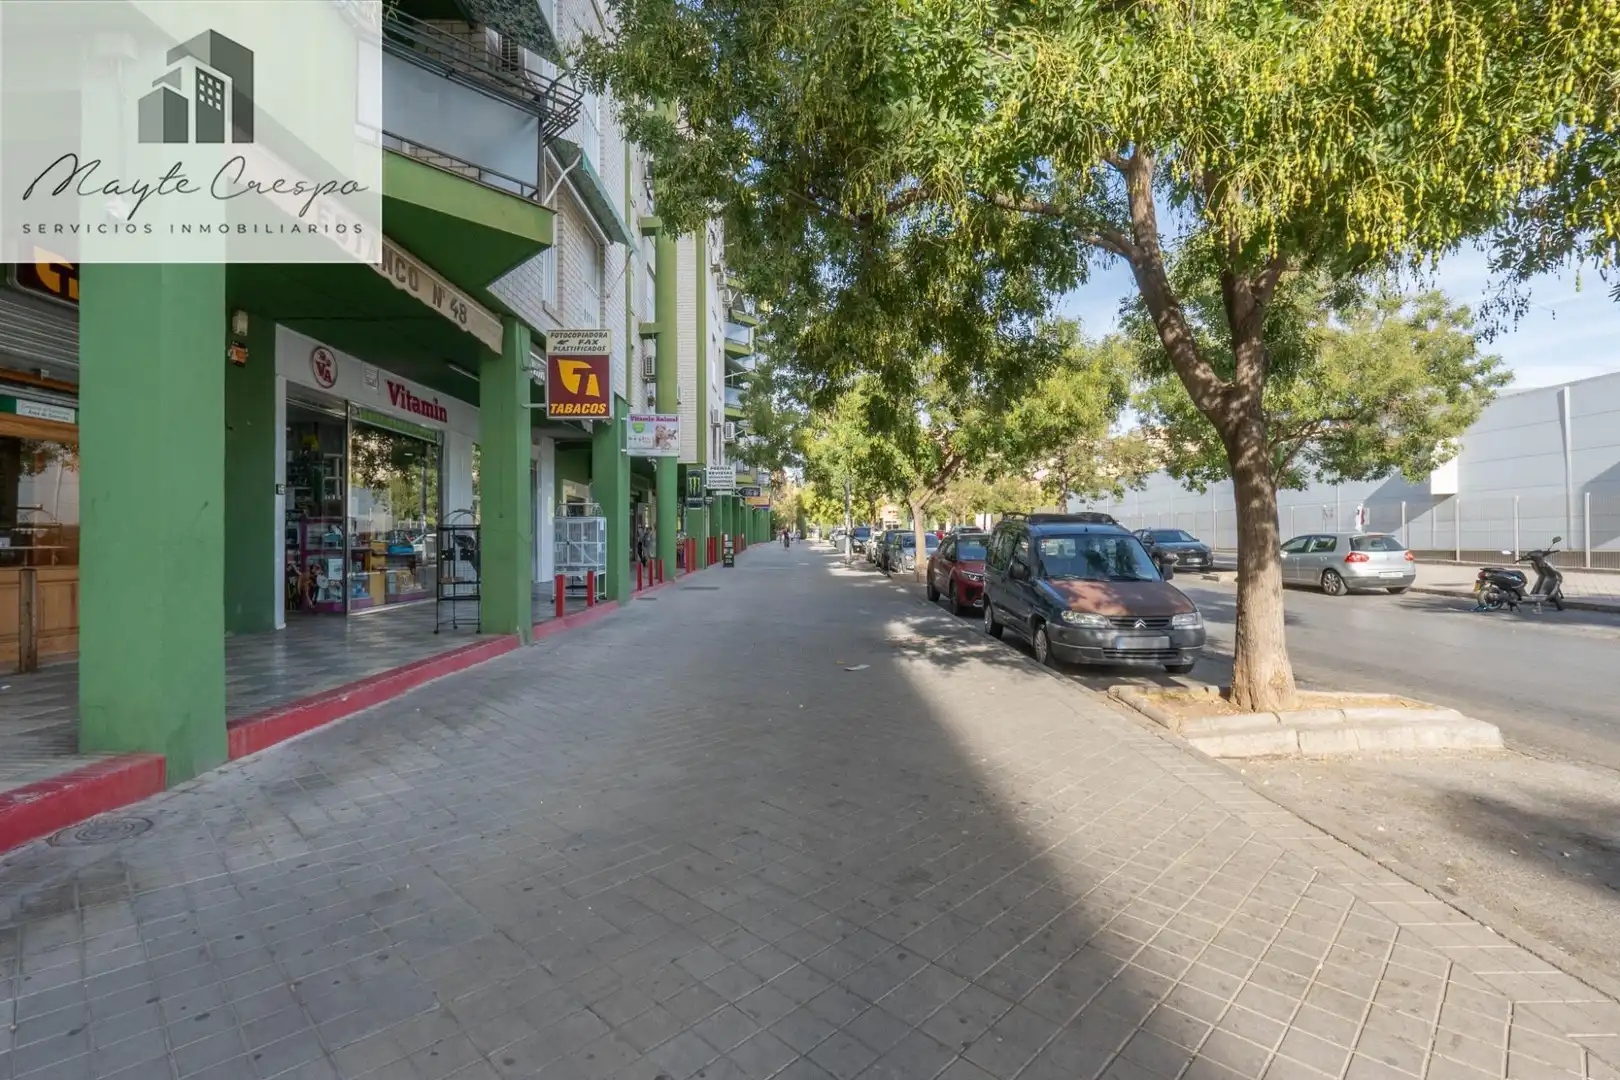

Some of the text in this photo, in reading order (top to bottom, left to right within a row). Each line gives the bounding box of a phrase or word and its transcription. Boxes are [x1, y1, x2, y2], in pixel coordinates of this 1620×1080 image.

[450, 298, 469, 326] 48
[385, 379, 448, 423] Vitamin
[550, 403, 607, 414] TABACOS
